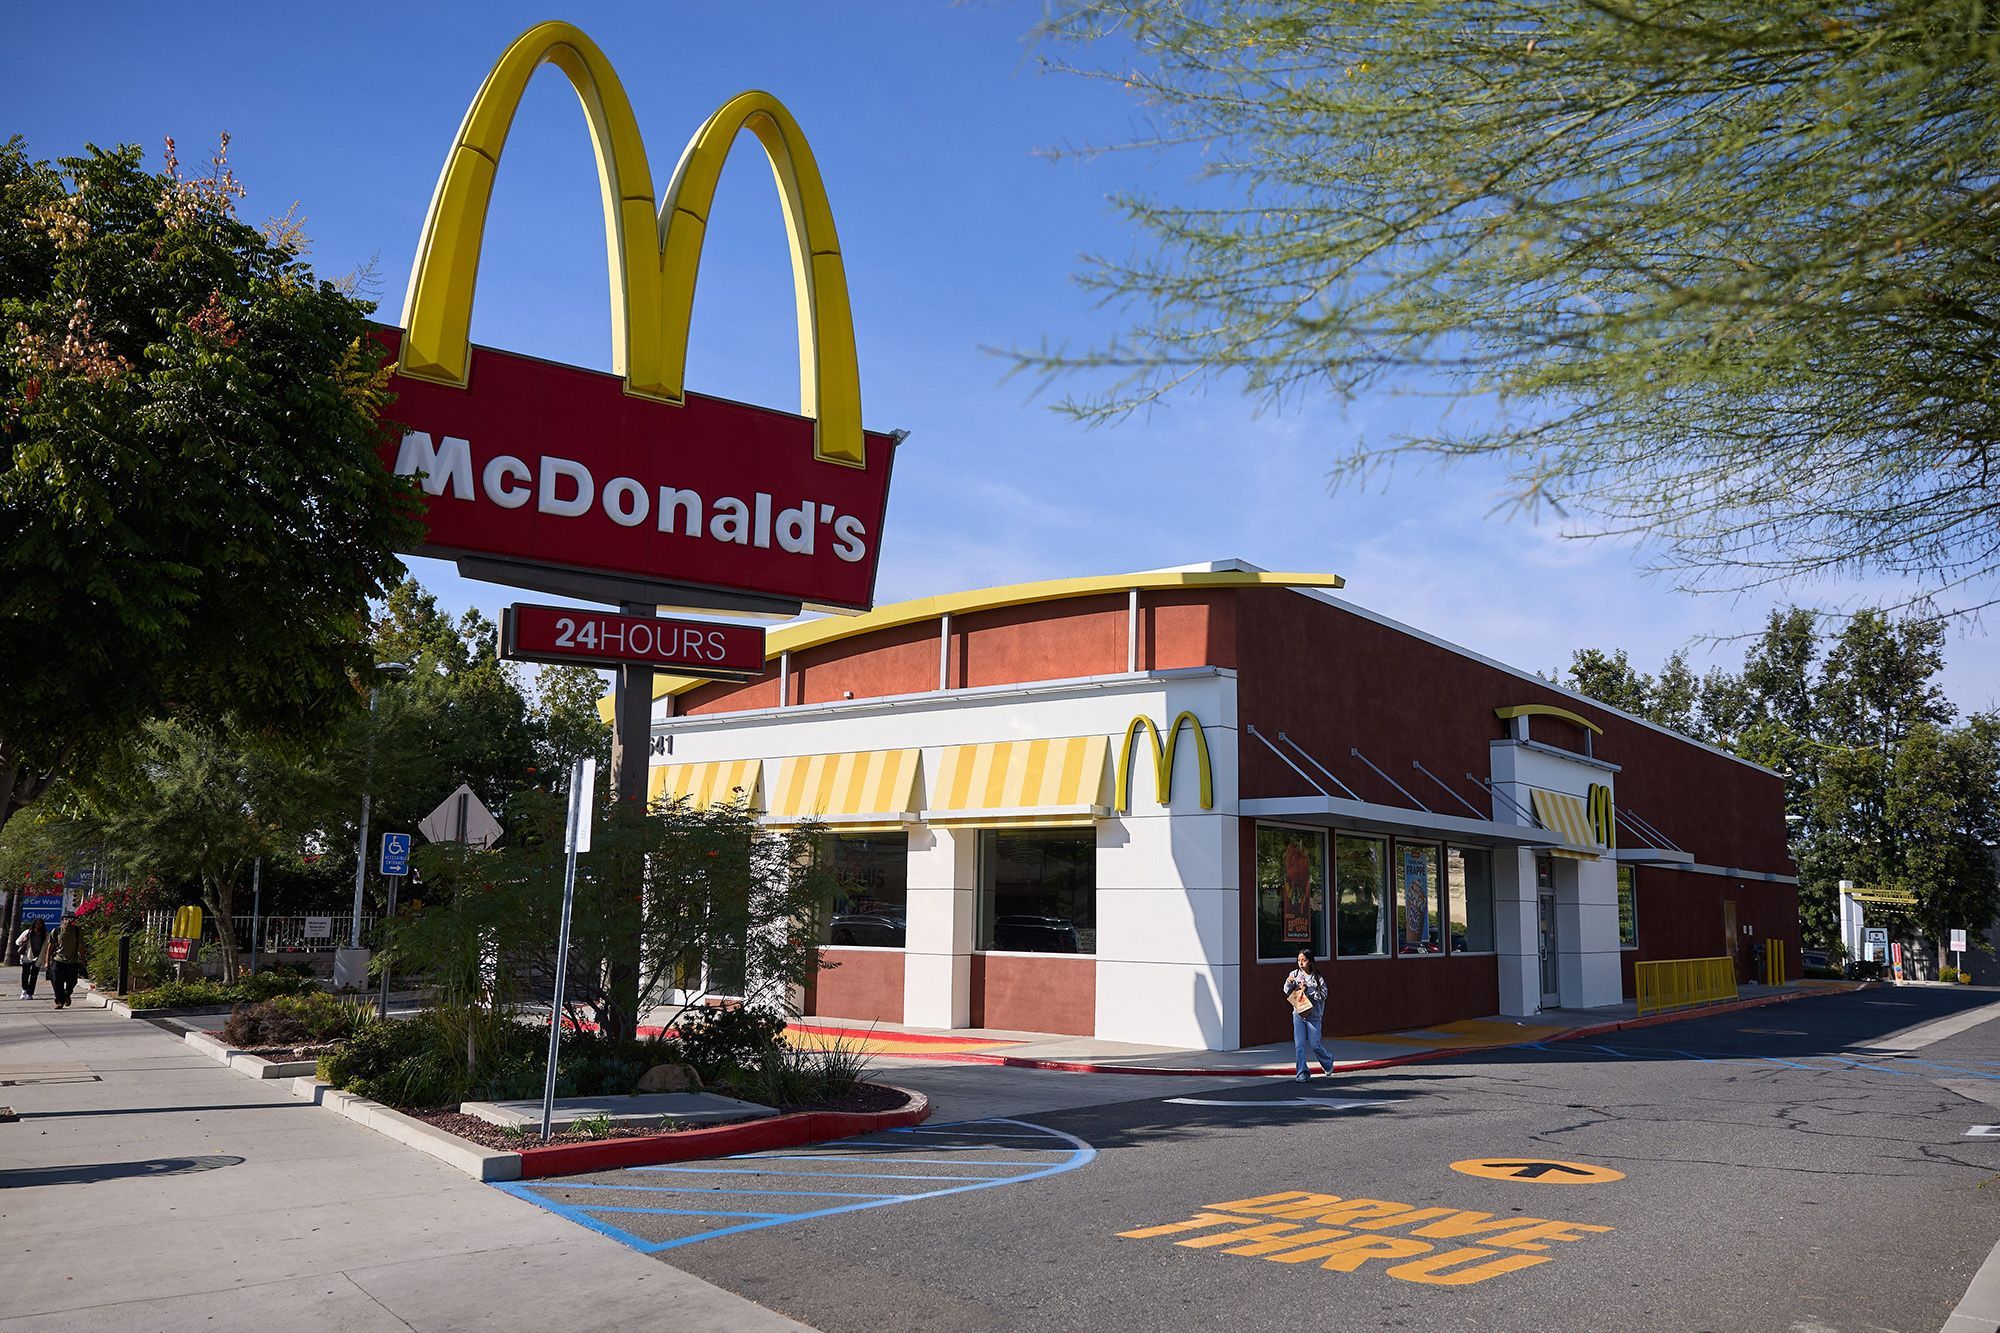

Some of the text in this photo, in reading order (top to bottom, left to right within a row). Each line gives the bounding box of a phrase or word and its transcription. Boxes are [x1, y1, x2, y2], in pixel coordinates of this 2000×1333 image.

[393, 430, 867, 562] McDonald's
[1115, 1212, 1554, 1285] THRU
[1201, 1190, 1616, 1251] DRIVE
